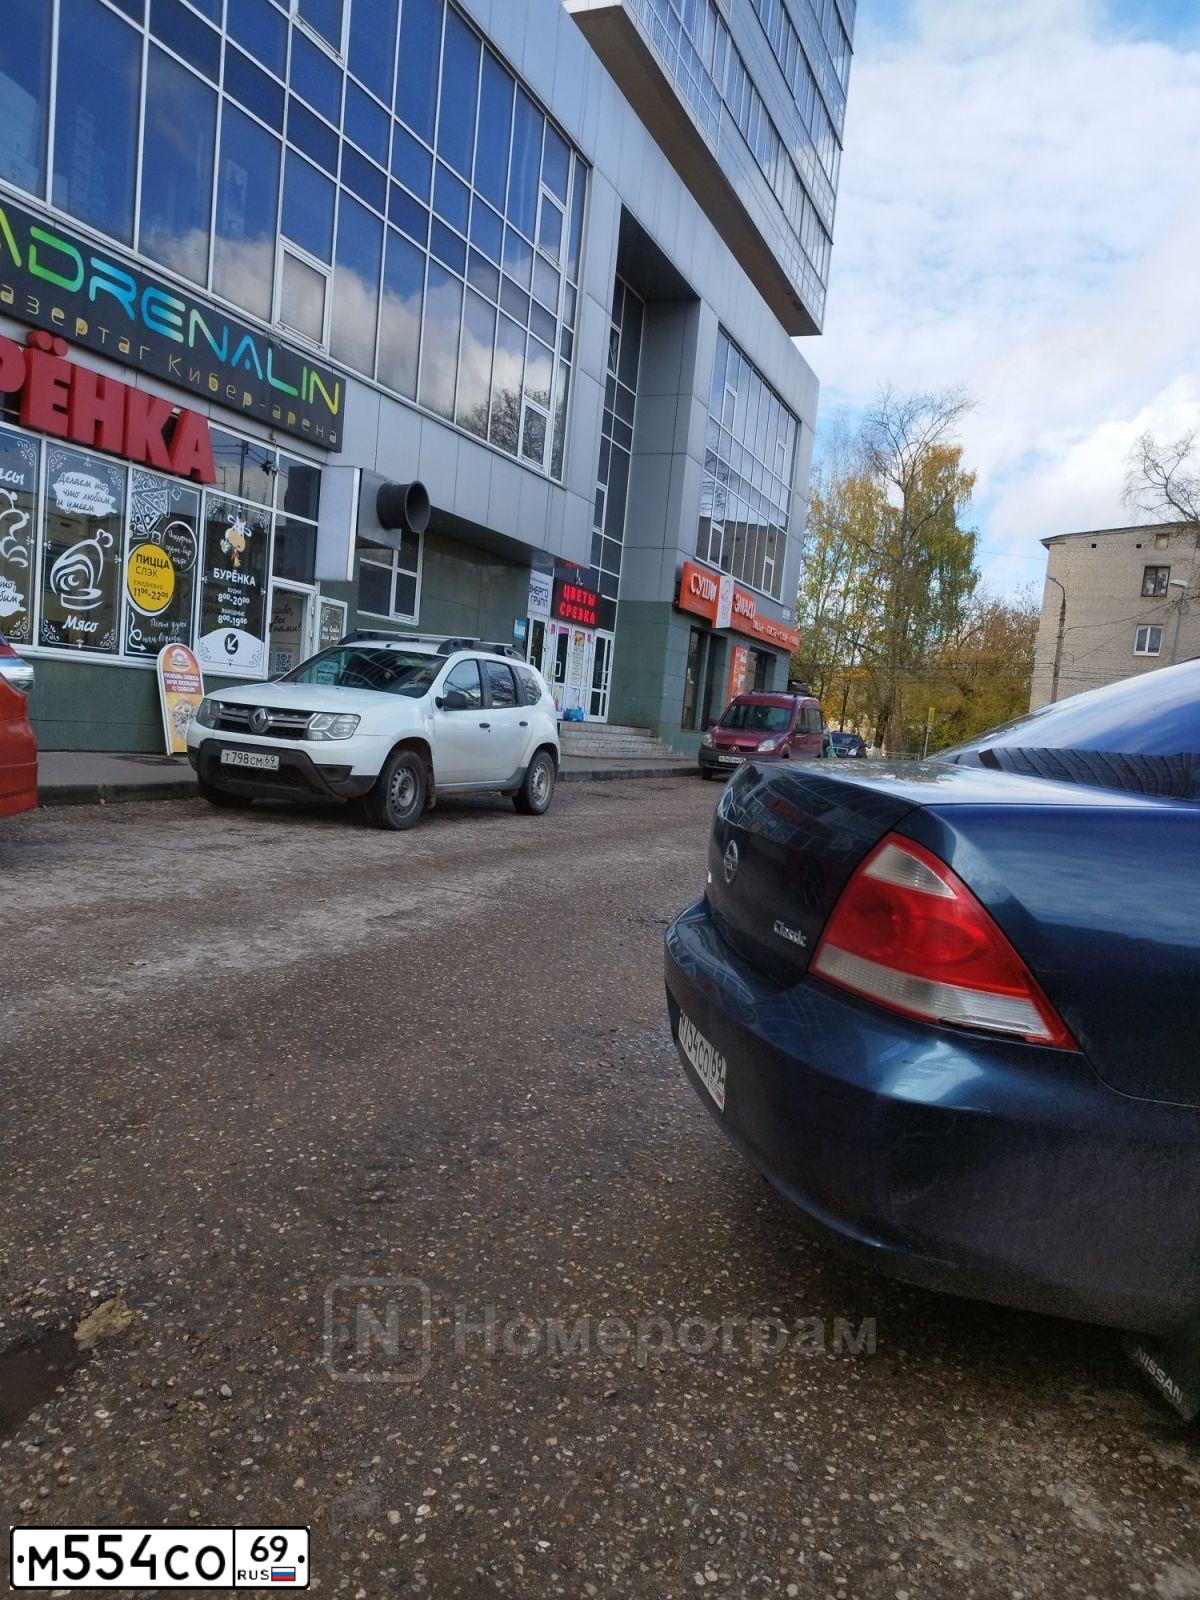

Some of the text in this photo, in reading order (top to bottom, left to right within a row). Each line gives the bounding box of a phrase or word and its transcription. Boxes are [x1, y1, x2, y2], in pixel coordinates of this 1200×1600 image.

[136, 553, 170, 570] ПИЦЦА
[213, 567, 256, 587] БУРЁНКА
[690, 572, 717, 602] СУШИ
[563, 583, 596, 606] ЦВЕТЫ
[62, 614, 99, 633] Мясо
[560, 601, 595, 625] СРЕЗКА
[774, 919, 808, 948] Classic
[1135, 1346, 1184, 1405] NISSAN
